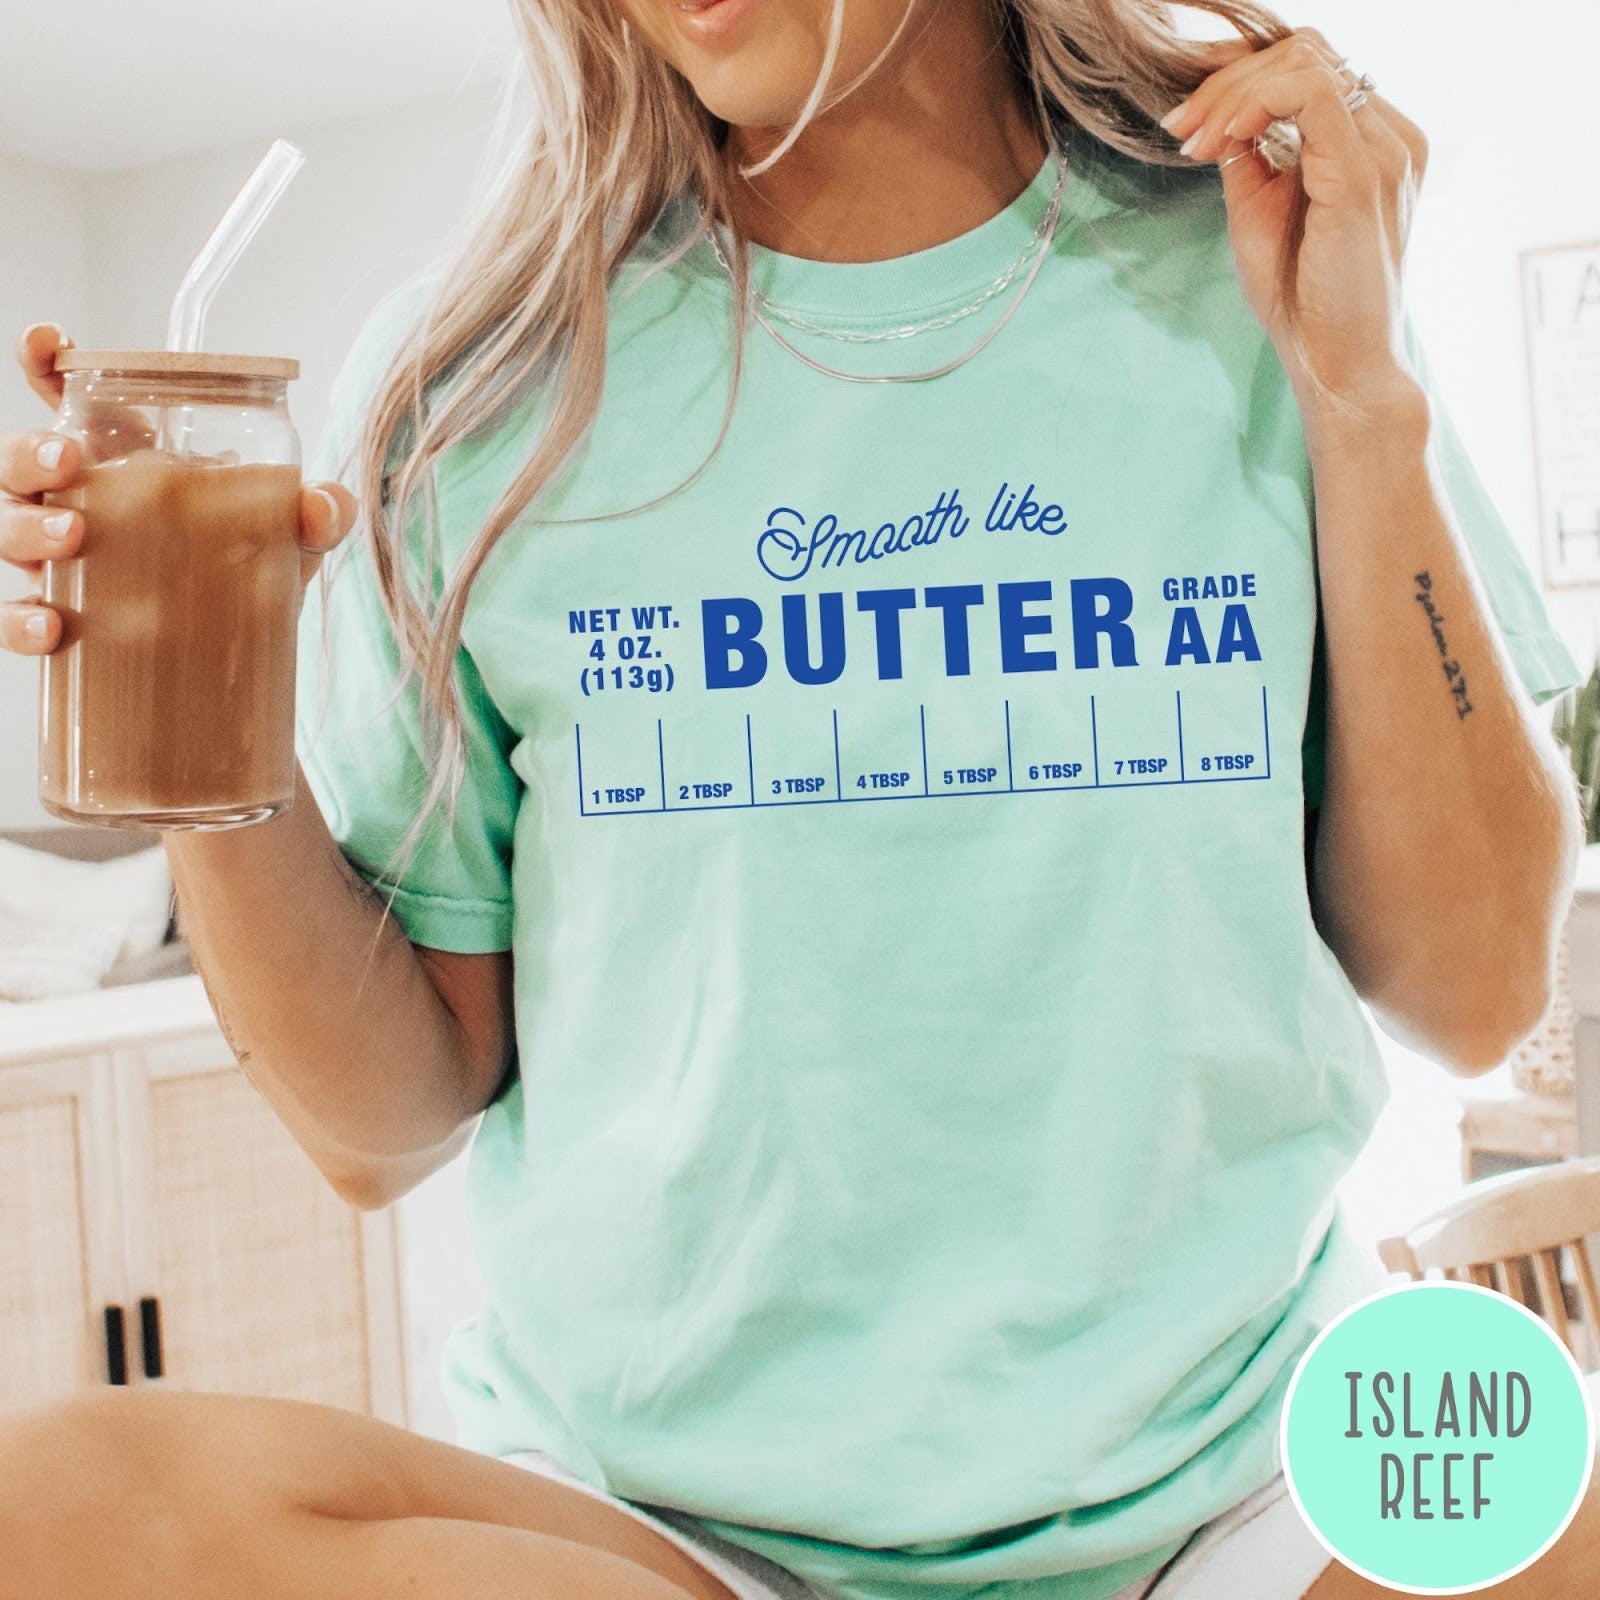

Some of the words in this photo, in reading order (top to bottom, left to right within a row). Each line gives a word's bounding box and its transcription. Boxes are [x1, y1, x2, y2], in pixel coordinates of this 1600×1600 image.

[755, 488, 970, 583] Smooth
[984, 482, 1068, 537] like
[1161, 572, 1257, 602] GRADE
[568, 607, 621, 634] NET
[630, 604, 680, 631] WT.
[700, 576, 1139, 691] BUTTER
[1164, 602, 1263, 667] AA
[588, 638, 606, 661] 4
[617, 635, 663, 661] OZ.
[580, 663, 675, 697] (113g)
[1027, 765, 1040, 781] 6
[1041, 762, 1083, 780] TBSP
[1115, 759, 1125, 775] 7
[1127, 757, 1169, 775] TBSP
[1200, 756, 1212, 772] 8
[1215, 754, 1255, 771] TBSP
[771, 779, 782, 795] 3
[784, 776, 827, 794] TBSP
[856, 774, 867, 790] 4
[870, 771, 911, 789] TBSP
[943, 769, 954, 785] 5
[957, 767, 998, 785] TBSP
[593, 789, 601, 804] 1
[605, 786, 646, 804] TBSP
[679, 785, 690, 801] 2
[692, 782, 734, 800] TBSP
